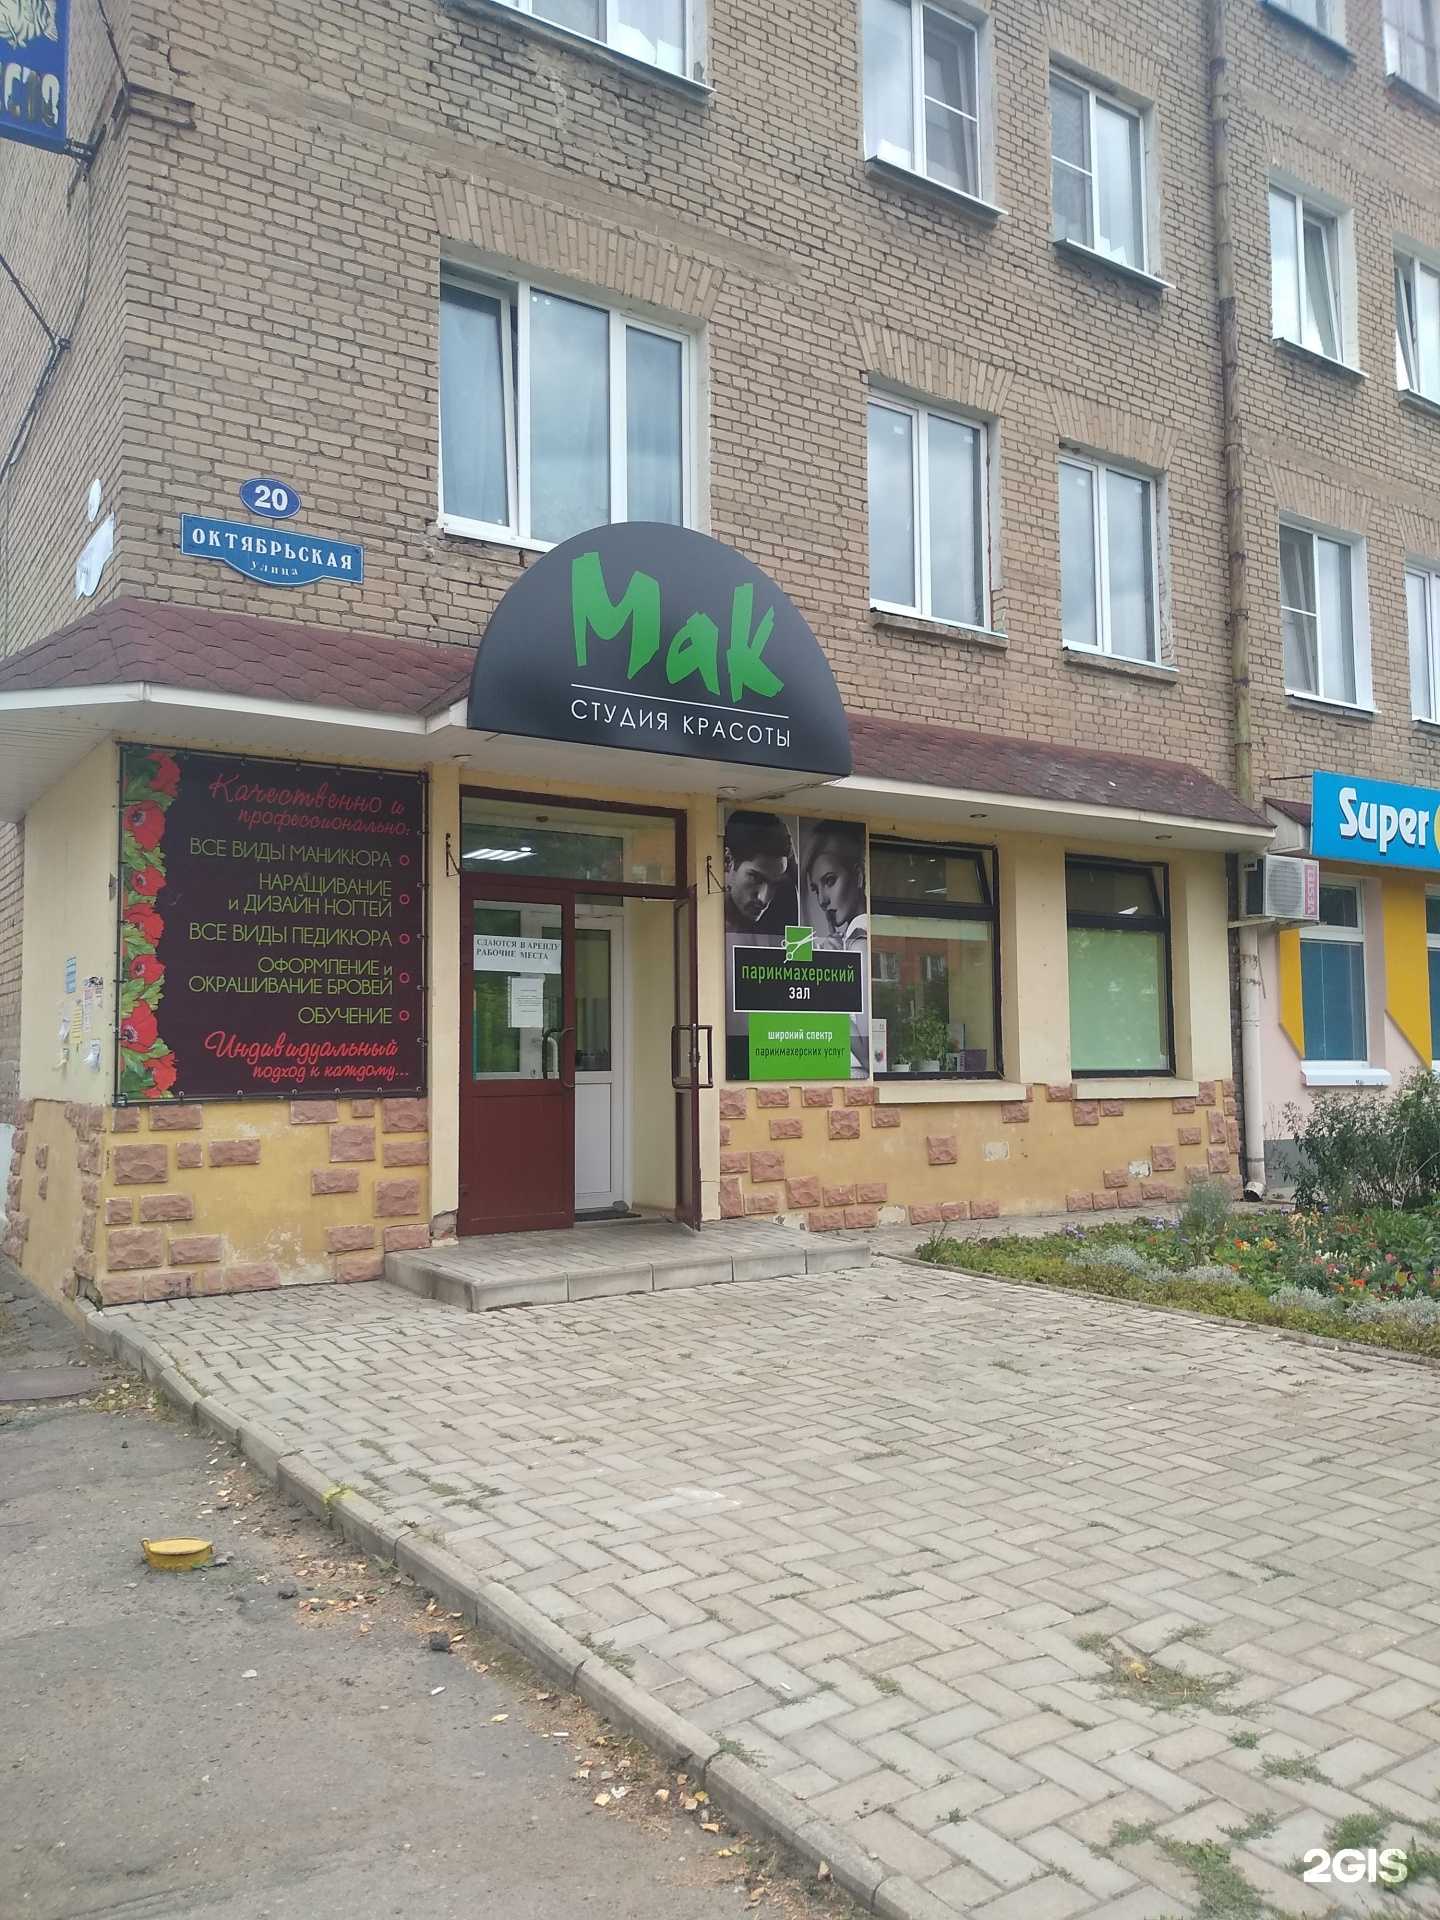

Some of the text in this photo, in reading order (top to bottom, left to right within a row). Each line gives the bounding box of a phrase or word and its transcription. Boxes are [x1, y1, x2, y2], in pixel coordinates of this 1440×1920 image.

[254, 485, 289, 511] 20
[192, 528, 352, 570] ОКТЯБРЬСКАЯ
[250, 560, 299, 577] улица
[571, 551, 785, 704] Мак
[571, 699, 791, 748] СТУДИЯ КРАСОТЫ
[208, 773, 405, 816] Качественно и
[238, 808, 411, 836] профессионально:
[1338, 787, 1430, 853] Super
[189, 837, 393, 868] ВСЕ ВИДЫ МАНИКЮРА
[259, 872, 393, 897] НАРАЩИВАНИЕ
[228, 893, 393, 918] и ДИЗАЙН НОГТЕЙ
[189, 922, 393, 948] ВСЕ ВИДЫ ПЕДИКЮРА
[476, 938, 517, 949] СДАЮТСЯ
[527, 942, 559, 951] АРЕНДУ
[257, 956, 393, 976] ОФОРМЛЕНИЕ и
[476, 948, 549, 960] РАБОЧИЕ МЕСТА
[188, 975, 393, 995] ОКРАШИВАНИЕ БРОВЕЙ
[741, 964, 855, 986] парикмахерский
[788, 987, 811, 1000] зал
[297, 1006, 393, 1025] ОБУЧЕНИЕ
[204, 1030, 400, 1064] Индивидуальный
[767, 1029, 833, 1042] широкий спектр
[755, 1046, 846, 1060] парикмахерских услуг
[253, 1064, 306, 1083] подход
[310, 1065, 320, 1077] к
